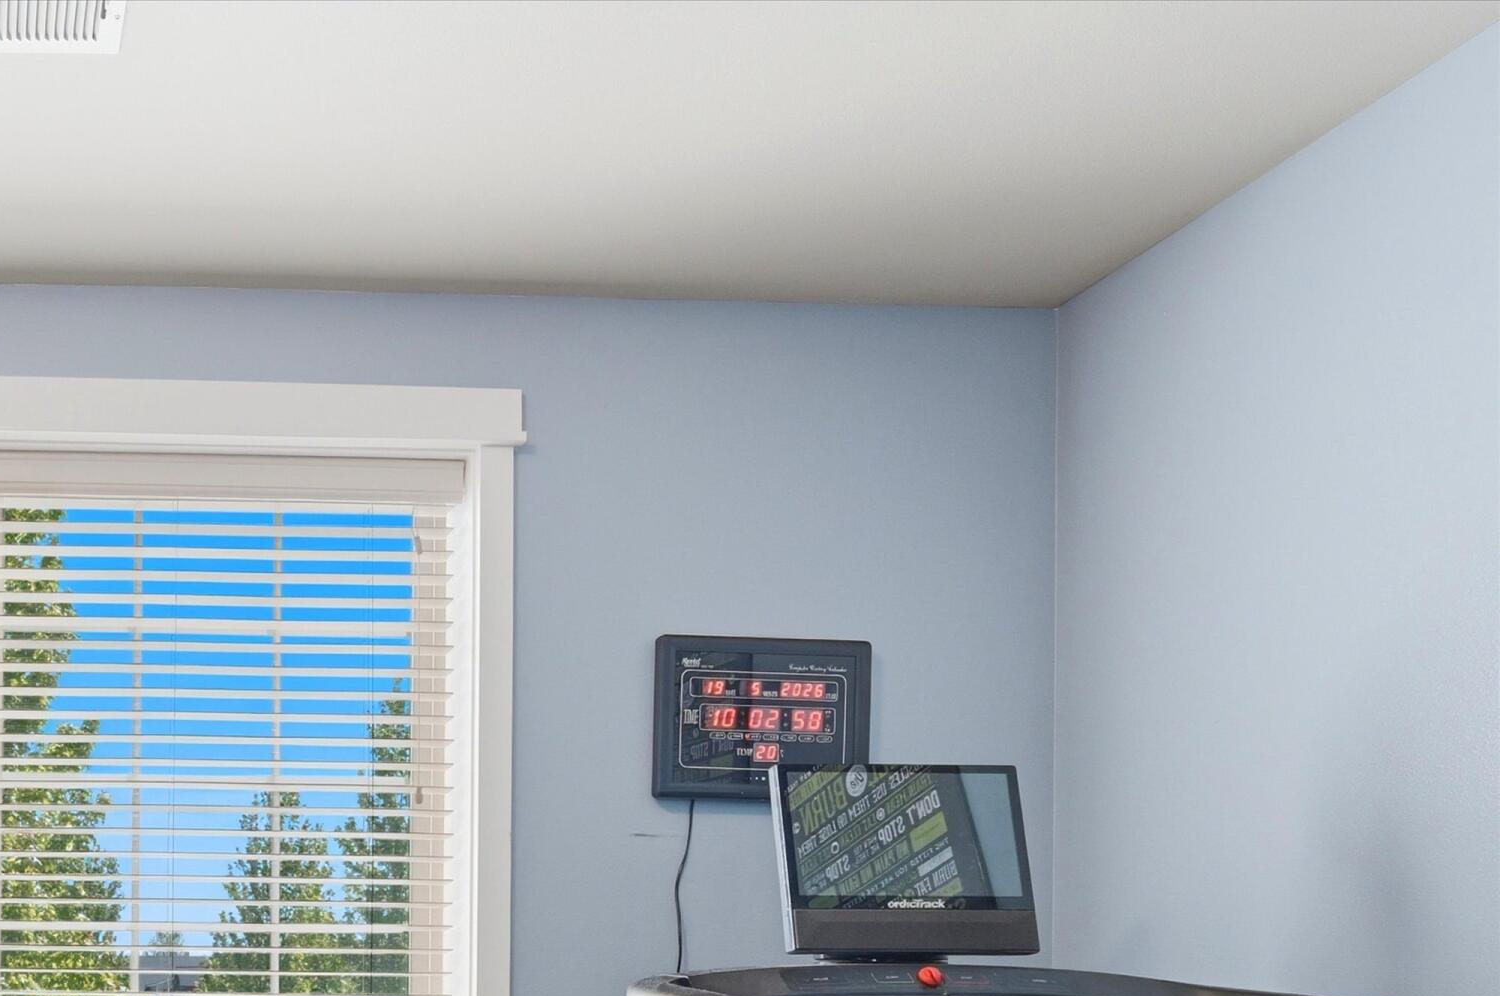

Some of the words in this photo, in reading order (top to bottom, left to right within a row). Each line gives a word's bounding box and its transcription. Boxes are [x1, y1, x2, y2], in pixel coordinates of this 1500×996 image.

[781, 682, 823, 698] 2026
[756, 745, 777, 759] 20
[886, 898, 946, 909] ordicTrack
